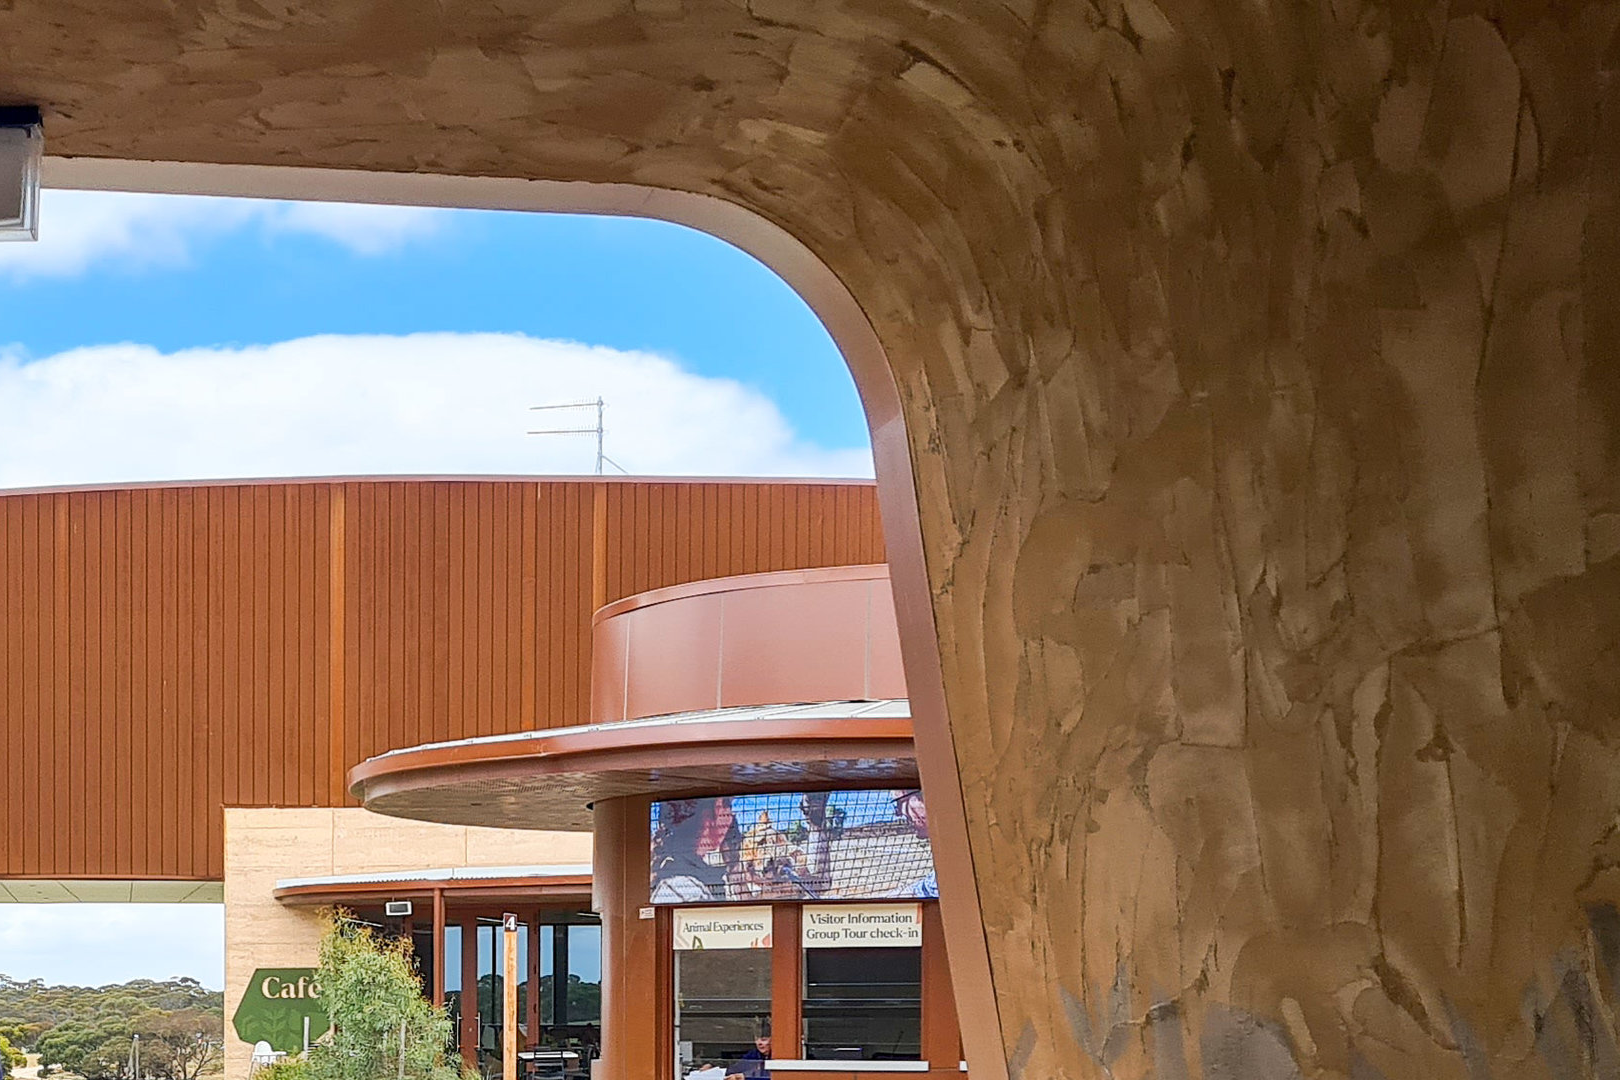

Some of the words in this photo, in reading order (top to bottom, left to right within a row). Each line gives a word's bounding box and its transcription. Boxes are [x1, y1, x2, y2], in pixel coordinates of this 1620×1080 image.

[505, 916, 517, 931] 4
[810, 914, 846, 925] Visitor
[848, 913, 913, 924] Information
[683, 922, 712, 932] Animal
[713, 921, 764, 934] Experiences
[806, 929, 840, 941] Group
[842, 929, 868, 939] Tour
[870, 927, 919, 938] check-in
